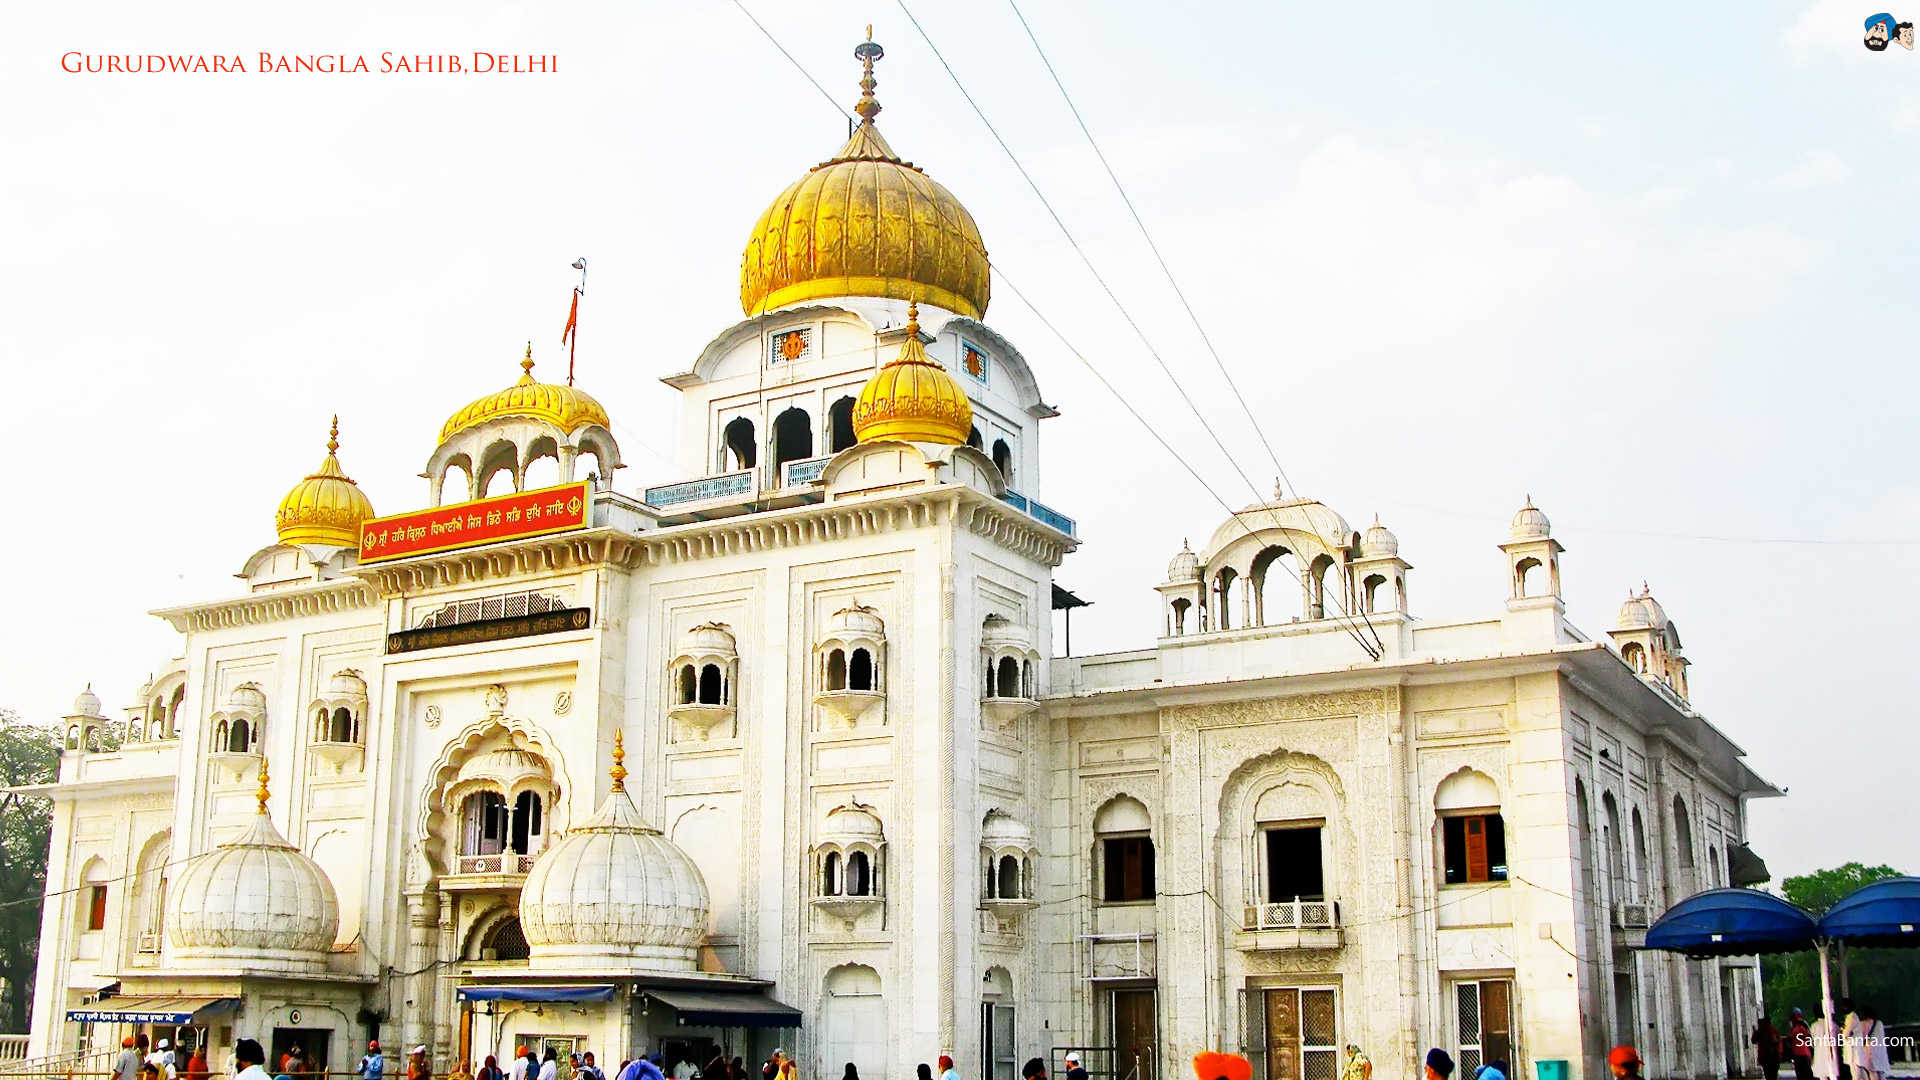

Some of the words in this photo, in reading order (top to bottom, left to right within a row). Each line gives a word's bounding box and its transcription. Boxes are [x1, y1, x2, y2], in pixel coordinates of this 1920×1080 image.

[391, 527, 405, 542] ਹਰਿ
[467, 514, 482, 529] ਜਿਸ
[546, 499, 564, 516] ਜਾਇ
